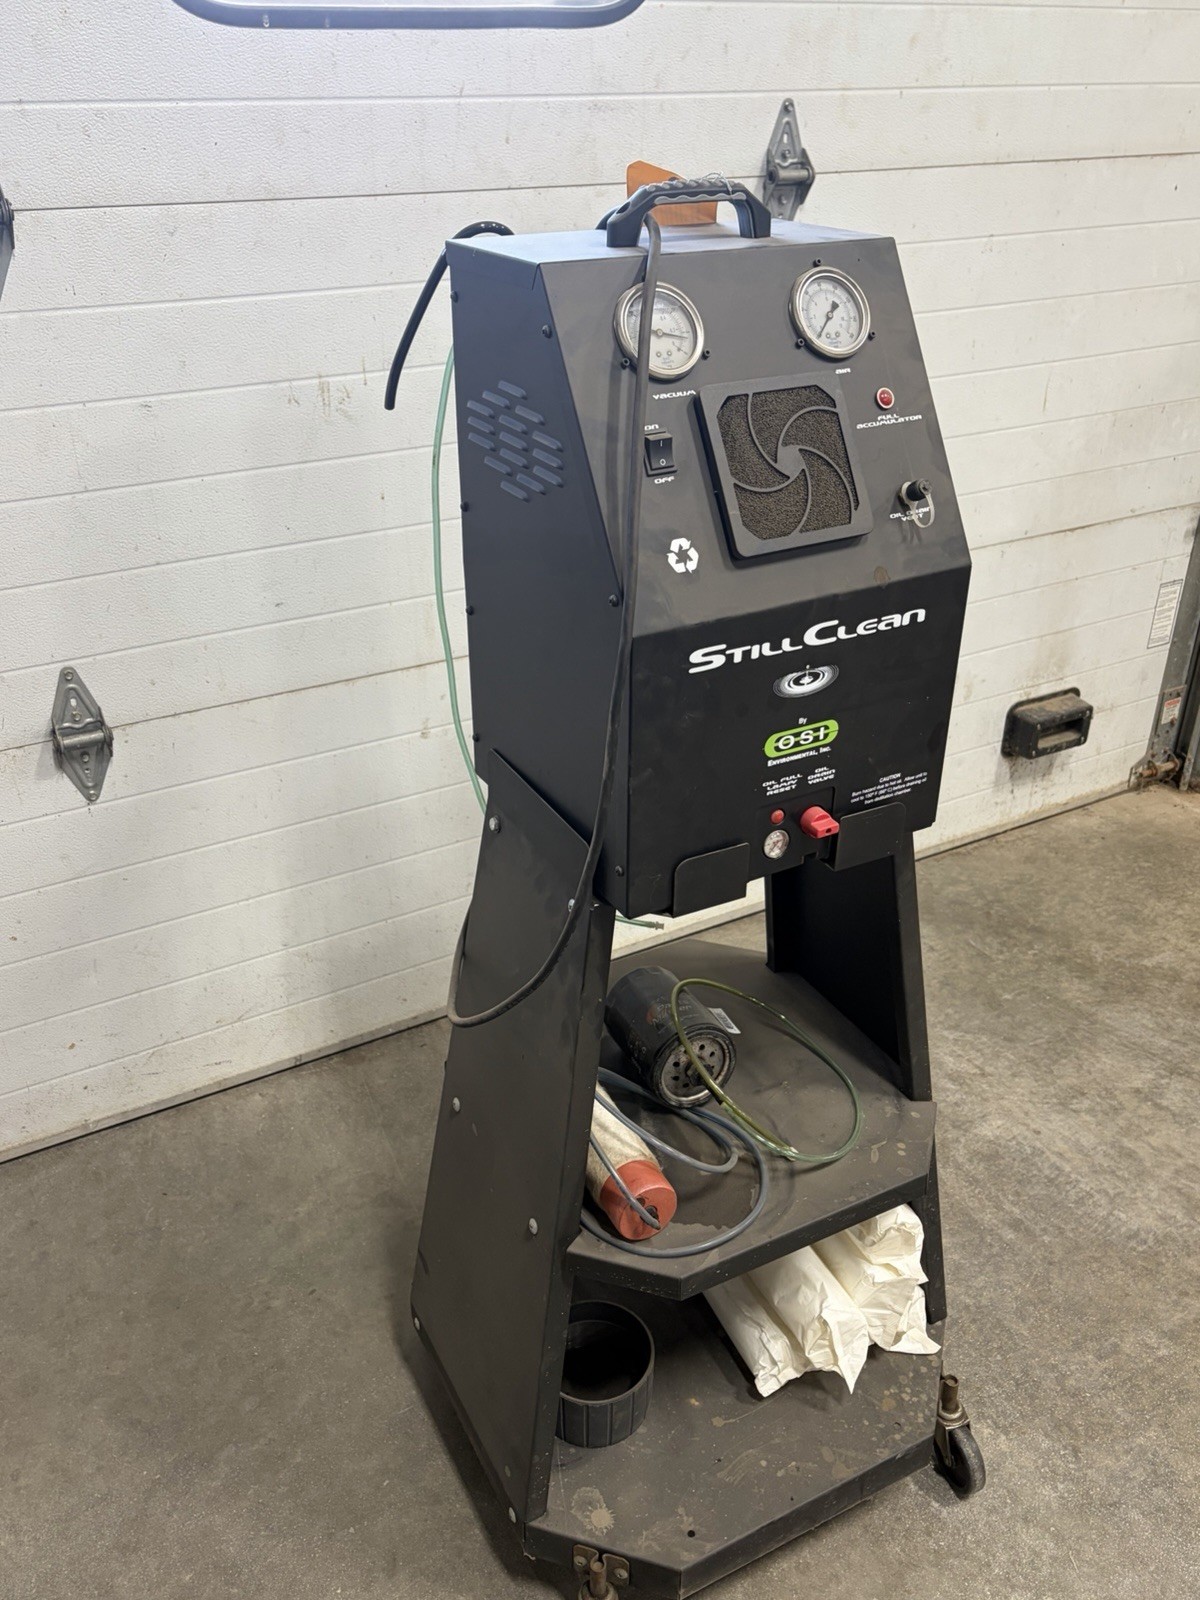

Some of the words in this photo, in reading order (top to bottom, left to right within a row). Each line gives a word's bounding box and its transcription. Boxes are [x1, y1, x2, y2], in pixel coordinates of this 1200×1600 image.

[652, 389, 697, 400] VACUUM
[856, 414, 923, 430] ACCUMULATOR
[877, 413, 900, 421] FULL
[644, 423, 659, 431] ON
[654, 475, 675, 485] OFF
[778, 726, 825, 750] OSI
[780, 773, 803, 782] FULL
[807, 769, 836, 780] DRAIN
[807, 774, 835, 785] VALVE
[879, 772, 902, 783] CAUTION
[766, 784, 797, 796] RESET
